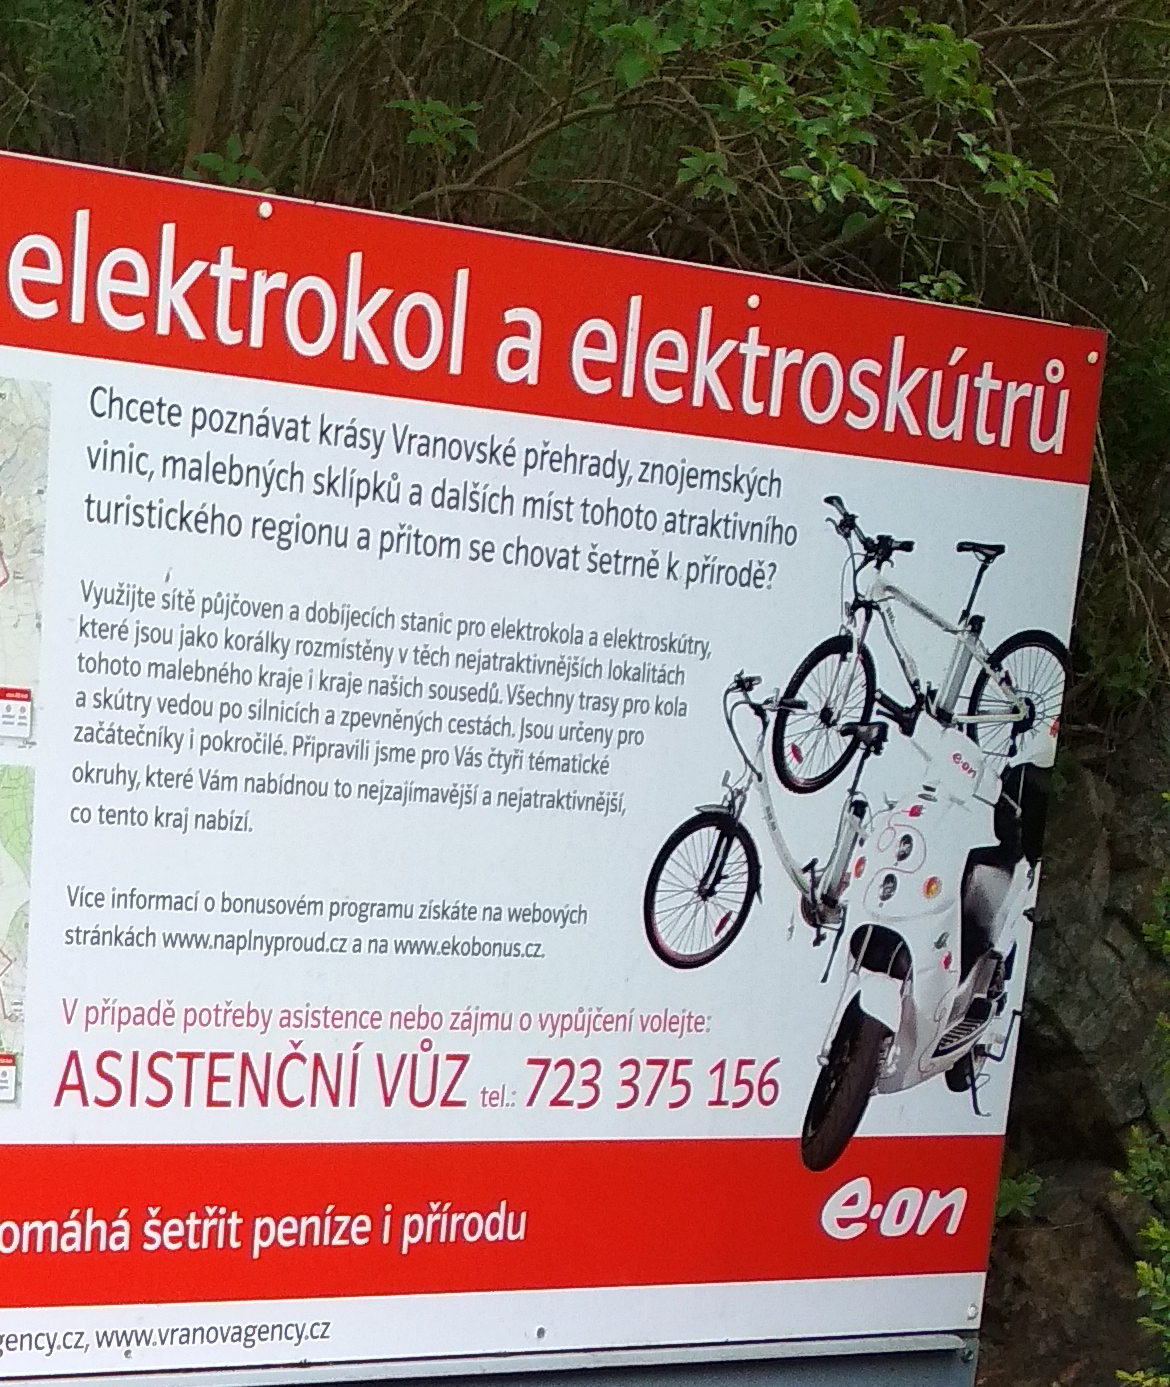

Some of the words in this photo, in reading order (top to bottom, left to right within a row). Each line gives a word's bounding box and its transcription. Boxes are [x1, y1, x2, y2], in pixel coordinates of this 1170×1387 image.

[7, 208, 470, 376] elektrokol
[495, 306, 542, 386] a
[570, 294, 1070, 455] elektroskútrů
[89, 385, 183, 428] Chcete
[190, 406, 312, 444] poznávat
[318, 412, 386, 460] krásy
[392, 422, 517, 468] Vranovské
[523, 439, 634, 489] přehrady,
[637, 457, 782, 503] znojemských
[86, 439, 155, 483] vinic,
[161, 450, 304, 499] malebných
[312, 464, 402, 508] sklípků
[408, 483, 423, 507] a
[430, 477, 515, 517] dalších
[522, 490, 575, 523] míst
[579, 496, 658, 532] tohoto
[663, 508, 798, 547] atraktivního
[83, 493, 243, 538] turistického
[250, 512, 349, 552] regionu
[356, 527, 371, 551] a
[468, 538, 496, 563] se
[502, 535, 581, 572] chovat
[586, 542, 660, 580] šetrně
[665, 550, 680, 582] k
[684, 554, 778, 591] přírodě?
[78, 613, 130, 642] které
[133, 619, 174, 649] jsou
[177, 623, 219, 653] jako
[223, 626, 291, 661] korálky
[295, 637, 395, 669] rozmístěny
[397, 647, 409, 664] v
[412, 643, 450, 668] těch
[455, 648, 604, 683] nejatraktivnějších
[607, 658, 686, 686] lokalitách
[80, 578, 156, 613] Využijte
[200, 591, 284, 622] půjčoven
[288, 604, 300, 622] a
[305, 599, 396, 632] dobíjecích
[400, 611, 453, 635] stanic
[456, 619, 486, 642] pro
[490, 616, 584, 646] elektrokola
[588, 630, 599, 647] a
[602, 626, 712, 662] elektroskútry,
[76, 650, 142, 678] tohoto
[147, 657, 253, 687] malebného
[257, 663, 304, 695] kraje
[308, 668, 314, 691] i
[318, 668, 363, 699] kraje
[367, 674, 424, 699] našich
[428, 681, 503, 705] sousedů.
[506, 683, 575, 716] Všechny
[578, 691, 620, 718] trasy
[621, 697, 651, 719] pro
[653, 694, 688, 718] kola
[73, 720, 185, 755] začátečníky
[189, 727, 195, 750] i
[199, 729, 288, 757] pokročilé.
[291, 734, 370, 764] Připravili
[373, 739, 417, 767] jsme
[420, 748, 450, 770] pro
[454, 744, 483, 768] Vás
[487, 747, 524, 775] čtyři
[75, 690, 87, 708] a
[92, 686, 153, 719] skútry
[156, 692, 214, 718] vedou
[218, 701, 243, 724] po
[247, 697, 320, 725] silnicích
[324, 708, 336, 726] a
[339, 707, 443, 738] zpevněných
[447, 714, 516, 739] cestách.
[517, 717, 555, 744] Jsou
[558, 720, 614, 750] určeny
[616, 729, 645, 751] pro
[70, 806, 92, 825] co
[97, 804, 149, 828] tento
[154, 805, 189, 835] kraj
[194, 808, 253, 833] nabízí.
[72, 760, 141, 793] okruhy,
[145, 764, 194, 790] které
[198, 767, 239, 793] Vám
[243, 771, 329, 798] nabídnou
[333, 778, 353, 799] to
[356, 779, 479, 810] nejzajímavější
[481, 789, 492, 807] a
[496, 786, 626, 818] nejatraktivnější,
[66, 884, 106, 909] Více
[111, 886, 201, 912] informací
[203, 895, 216, 913] o
[220, 890, 324, 916] bonusovém
[328, 900, 415, 924] programu
[418, 898, 478, 922] získáte
[481, 905, 503, 922] na
[507, 901, 588, 930] webových
[64, 923, 157, 948] stránkách
[161, 928, 348, 957] www.naplnyproud.cz
[351, 937, 363, 954] a
[367, 937, 389, 955] na
[393, 934, 546, 959] www.ekobonus.cz.
[62, 997, 79, 1025] V
[84, 997, 176, 1034] případě
[182, 999, 273, 1036] potřeby
[278, 1002, 383, 1031] asistence
[389, 1004, 444, 1031] nebo
[448, 1005, 513, 1038] zájmu
[518, 1012, 533, 1032] o
[537, 1006, 636, 1039] vypůjčení
[639, 1007, 712, 1040] volejte:
[53, 1039, 364, 1109] ASISTENČNÍ
[375, 1040, 471, 1109] VŮZ
[480, 1084, 516, 1108] tel.:
[525, 1057, 602, 1110] 723
[615, 1057, 694, 1110] 375
[707, 1056, 781, 1110] 156
[142, 1205, 244, 1251] šetřit
[252, 1204, 372, 1260] peníze
[382, 1203, 393, 1245] i
[401, 1199, 527, 1255] přírodu
[94, 1321, 331, 1354] www.vranovagency.cz
